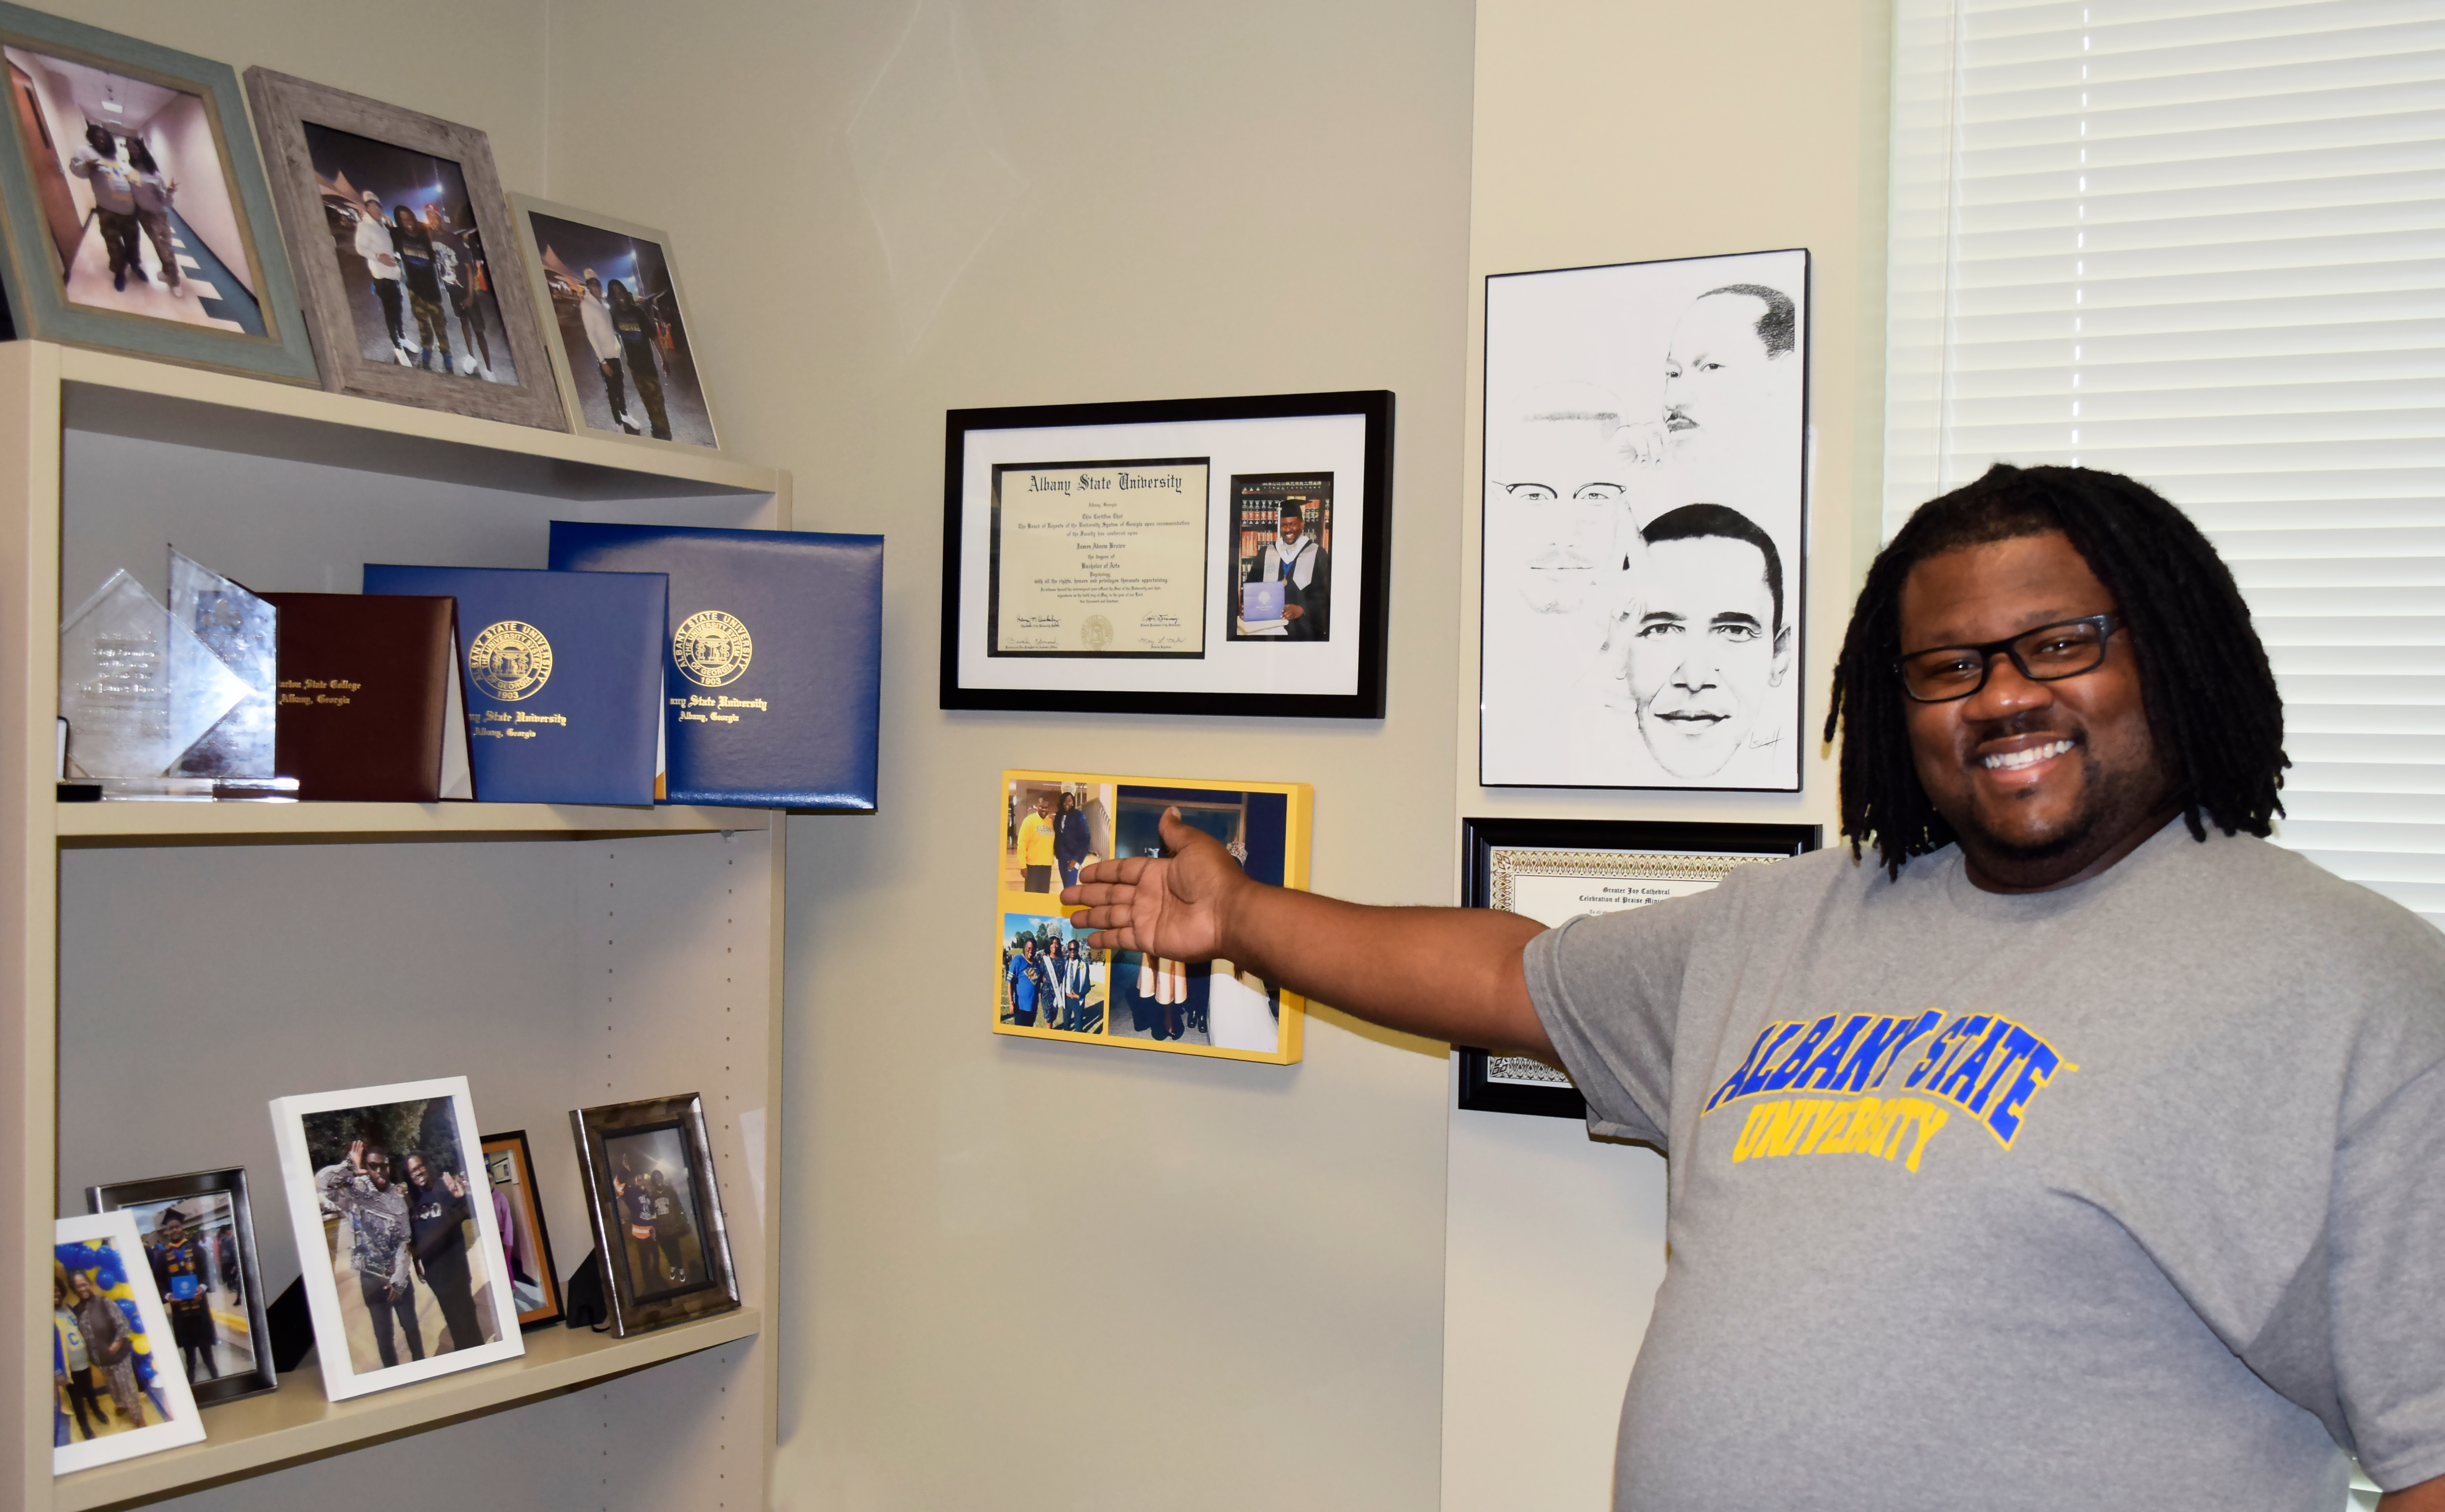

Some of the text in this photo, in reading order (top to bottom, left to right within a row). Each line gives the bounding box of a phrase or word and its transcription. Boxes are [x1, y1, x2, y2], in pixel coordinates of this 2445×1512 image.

[1027, 472, 1182, 497] Albany State University
[676, 613, 751, 670] ALBANY STATE UNIVERSITY
[689, 622, 728, 640] UNIVERSITY
[727, 629, 741, 657] SYSTEM
[471, 623, 551, 683] ALBANY STATE UNIVERSITY
[485, 633, 527, 652] UNIVERSITY
[526, 639, 541, 670] SYSTEM
[691, 661, 734, 676] OF GEORGIA
[303, 679, 327, 690] State
[330, 680, 361, 692] College
[487, 675, 533, 689] OF GEORGIA
[317, 694, 350, 706] Georgia
[497, 691, 519, 699] 1903
[688, 694, 716, 708] State
[717, 695, 768, 712] University
[483, 710, 512, 723] State
[515, 711, 567, 727] University
[678, 710, 740, 724] Albany, Georgia
[506, 728, 536, 739] Georgia
[1700, 1007, 2064, 1151] ALBANY STATE
[1732, 1096, 1950, 1174] UNIVERSITY
